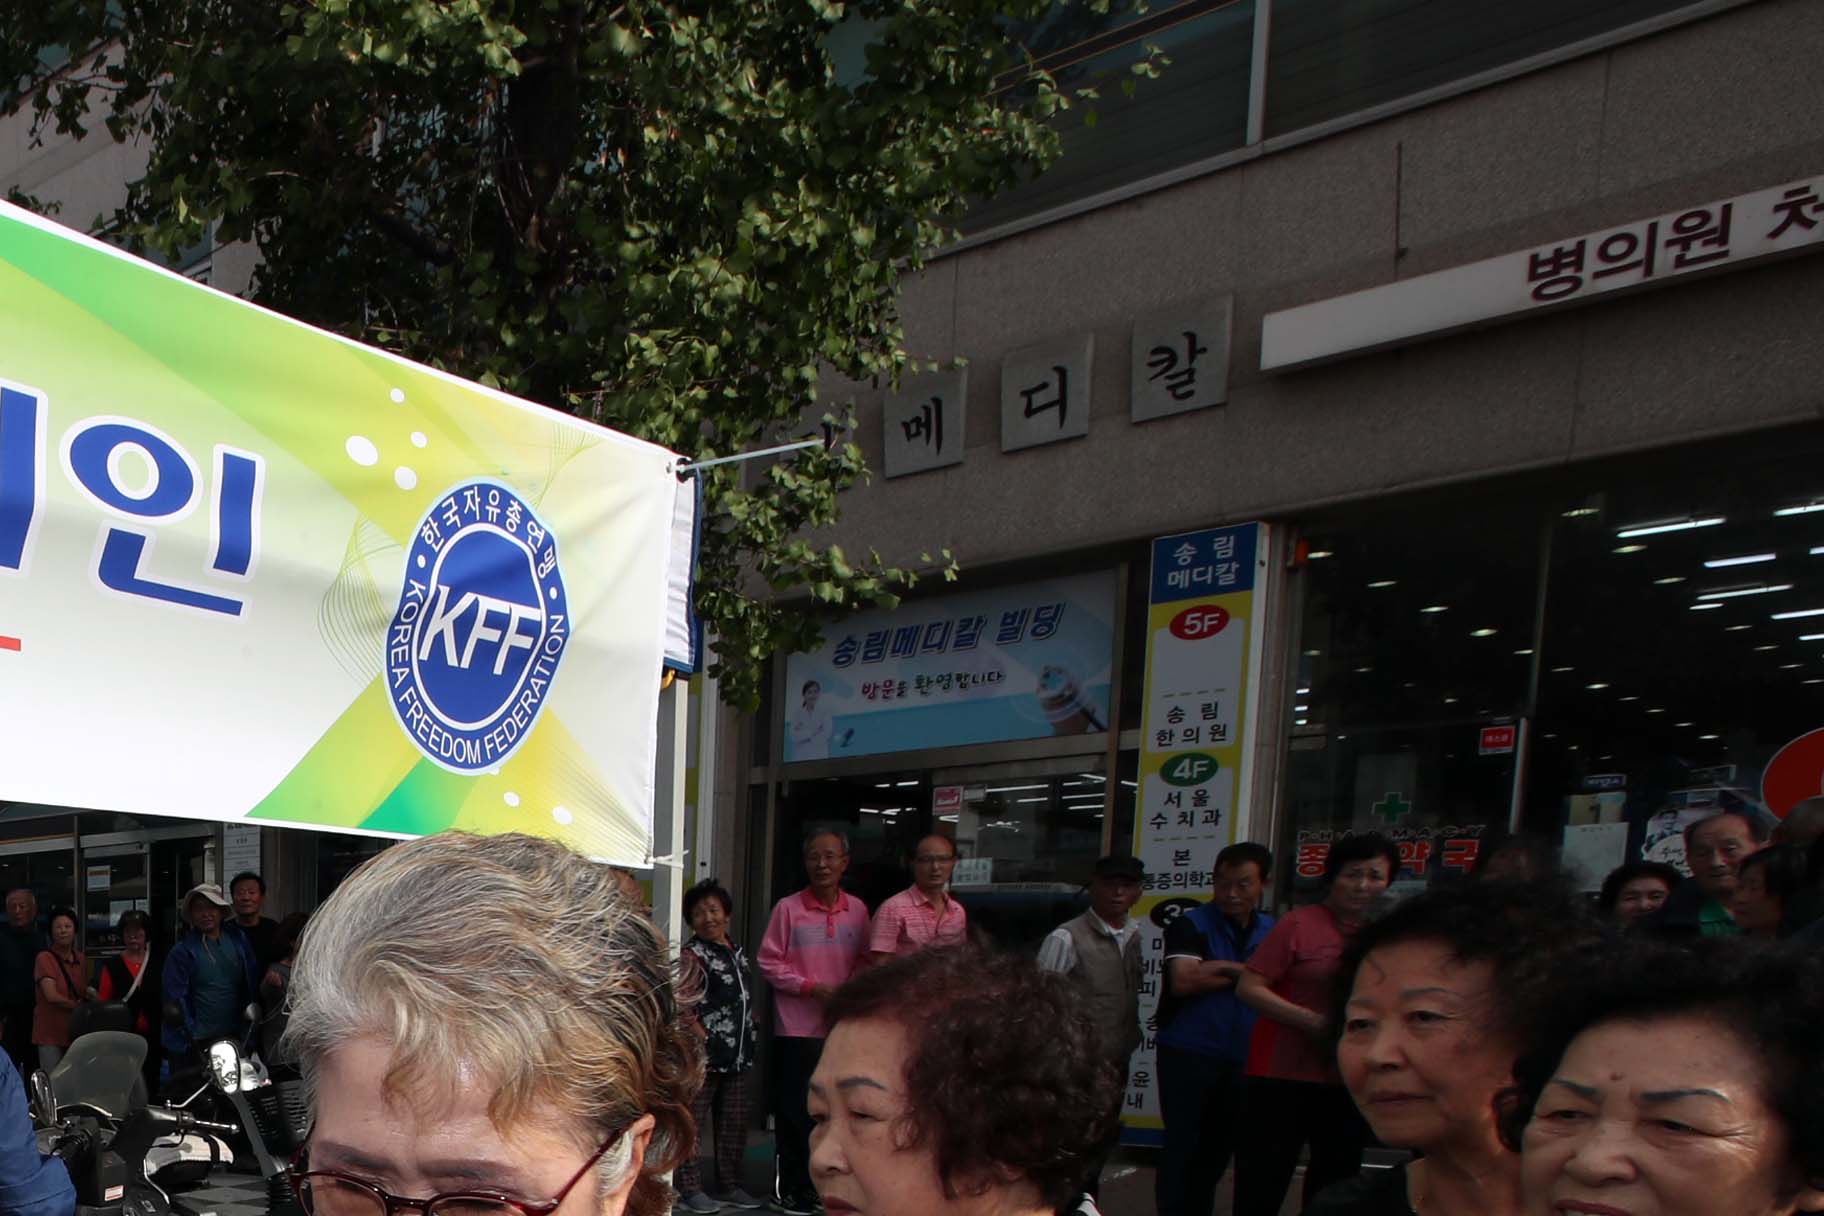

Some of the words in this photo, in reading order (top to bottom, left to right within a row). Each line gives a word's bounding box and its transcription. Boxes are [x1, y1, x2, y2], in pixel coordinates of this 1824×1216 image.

[1527, 203, 1734, 302] 병의원
[420, 485, 557, 578] 한국자유총연맹
[1167, 561, 1240, 589] 메디칼
[391, 578, 426, 689] KOREA
[418, 584, 542, 675] KFF
[831, 615, 987, 669] 송림메디칼
[995, 602, 1067, 647] 빌딩
[1183, 612, 1221, 635] 5F
[484, 614, 565, 761] FEDERATION
[862, 680, 907, 699] 방문을
[912, 669, 1007, 698] 환영합니다
[398, 686, 482, 765] FREEDOM
[1172, 757, 1210, 779] 4F
[1172, 848, 1192, 867] 본
[1296, 839, 1480, 878] 종약국
